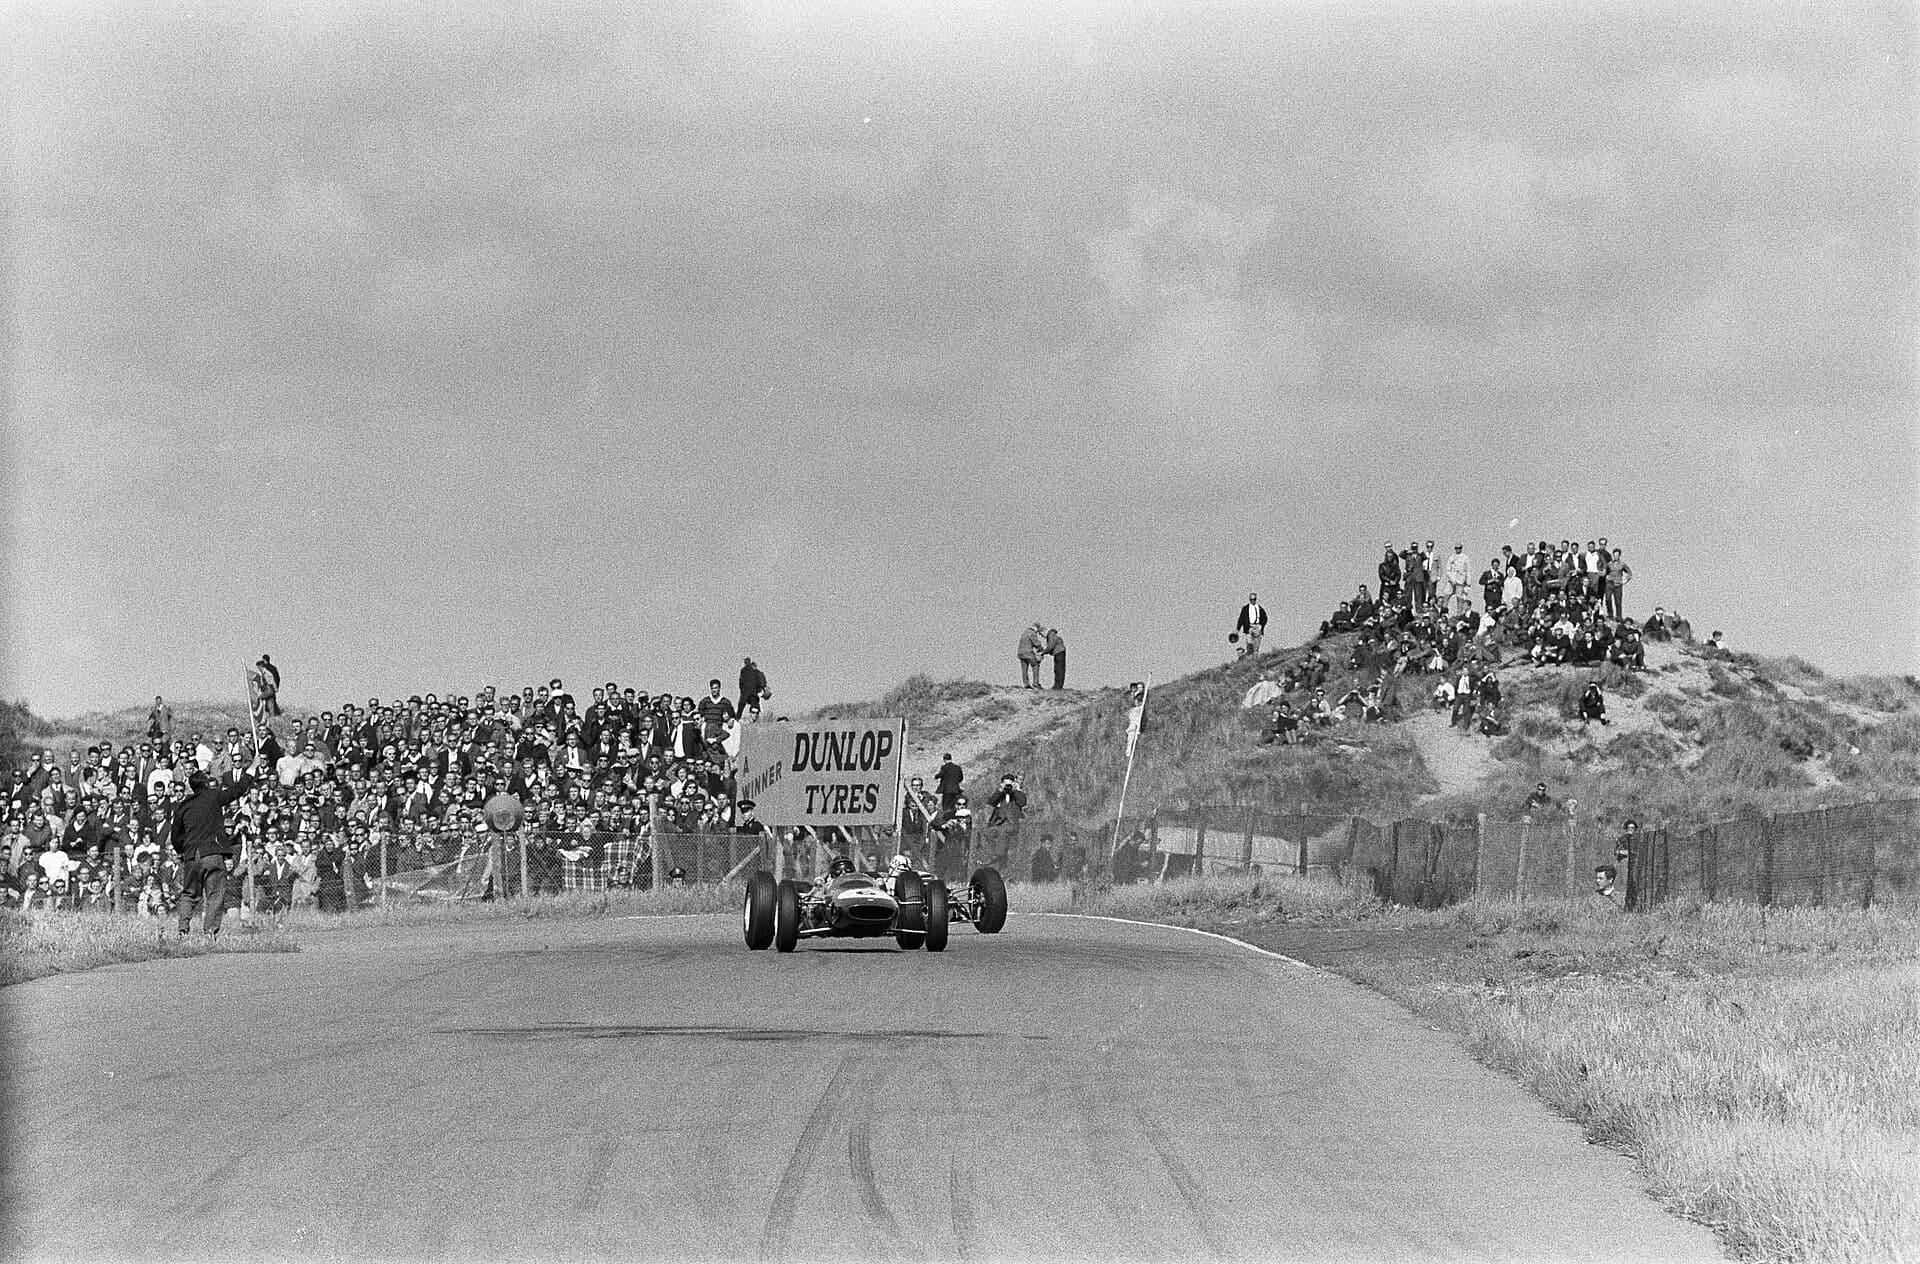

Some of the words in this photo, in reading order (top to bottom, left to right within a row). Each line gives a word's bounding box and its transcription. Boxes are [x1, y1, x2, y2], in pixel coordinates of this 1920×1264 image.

[742, 756, 749, 777] A
[792, 730, 893, 771] DUNLOP
[742, 761, 782, 800] WINNER
[805, 783, 880, 814] TYRES
